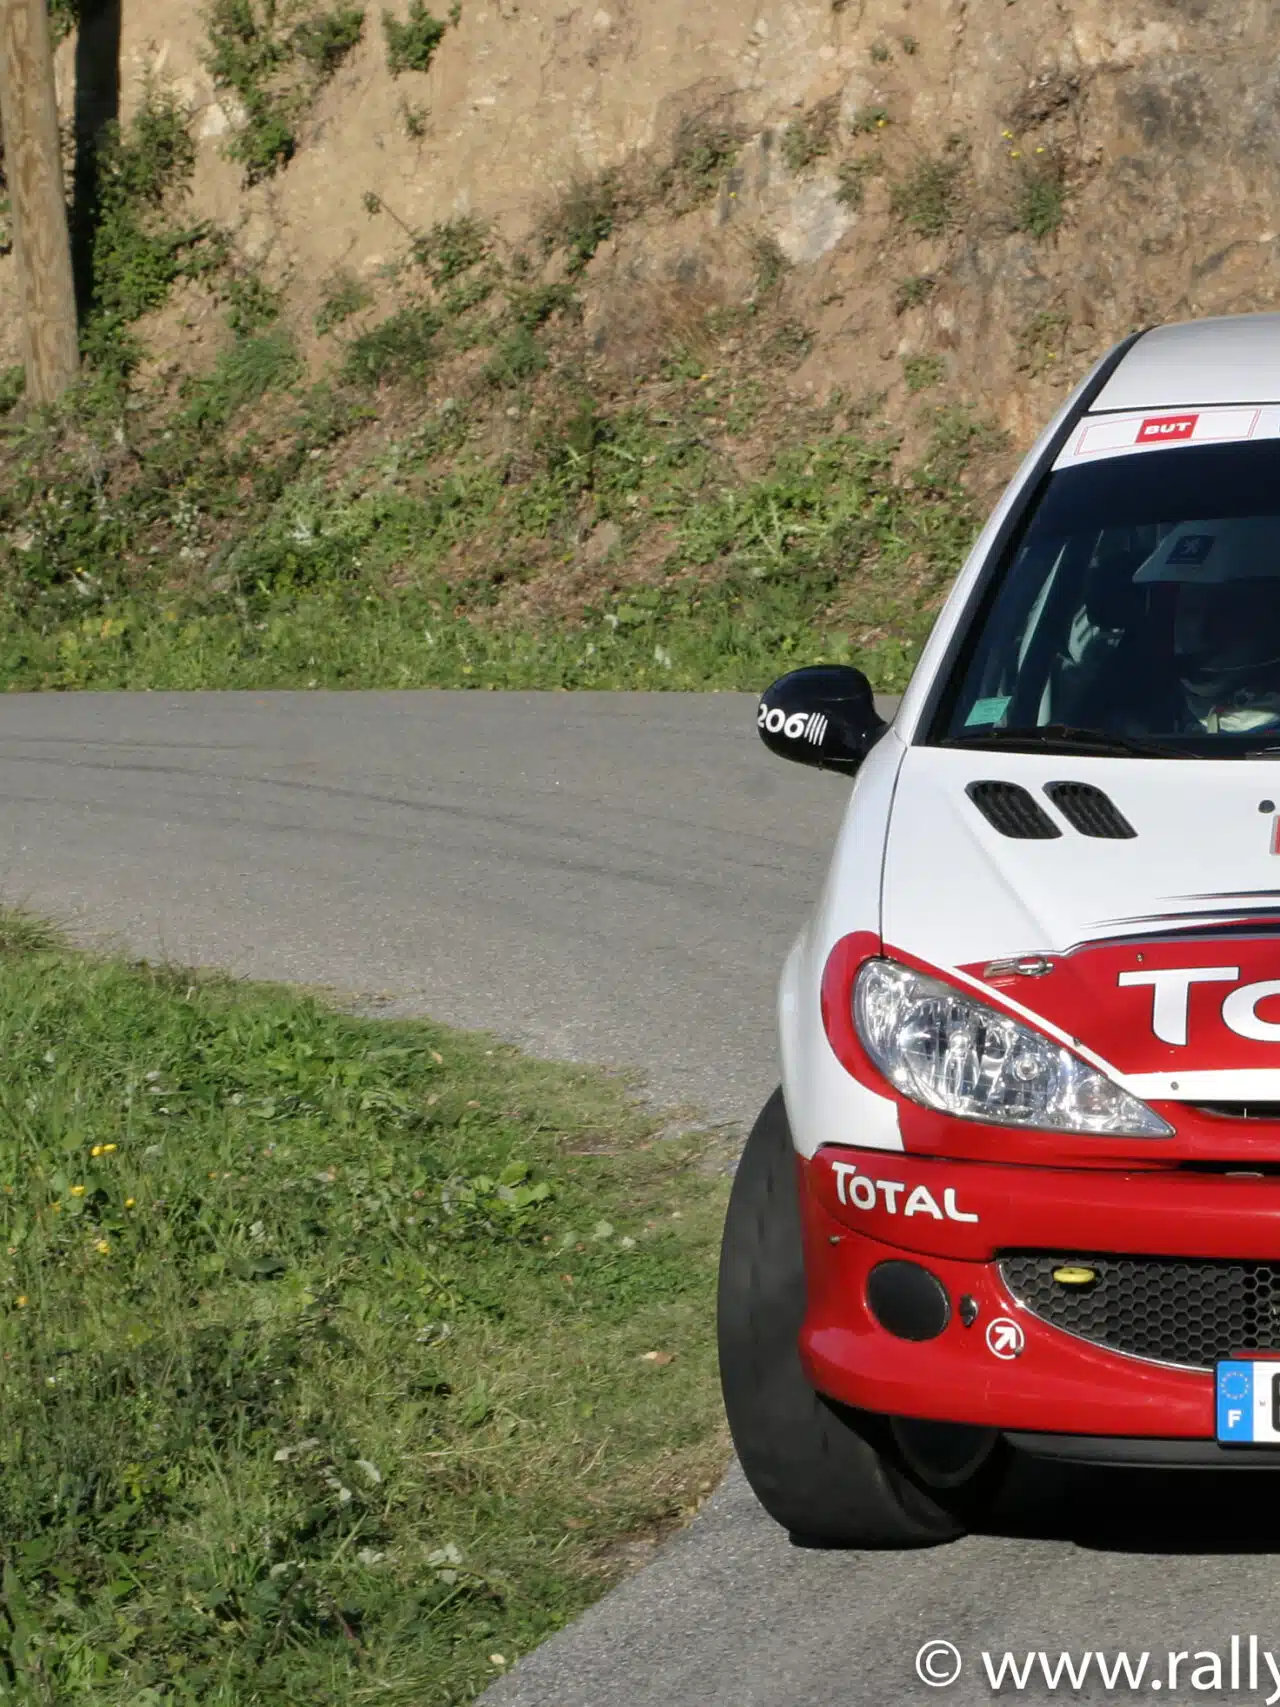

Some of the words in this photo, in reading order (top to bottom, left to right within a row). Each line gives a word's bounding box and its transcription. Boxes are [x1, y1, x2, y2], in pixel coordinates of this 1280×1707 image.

[1144, 421, 1191, 436] BUT
[758, 703, 809, 739] 206
[832, 1161, 979, 1223] TOTAL
[1228, 1410, 1242, 1428] F
